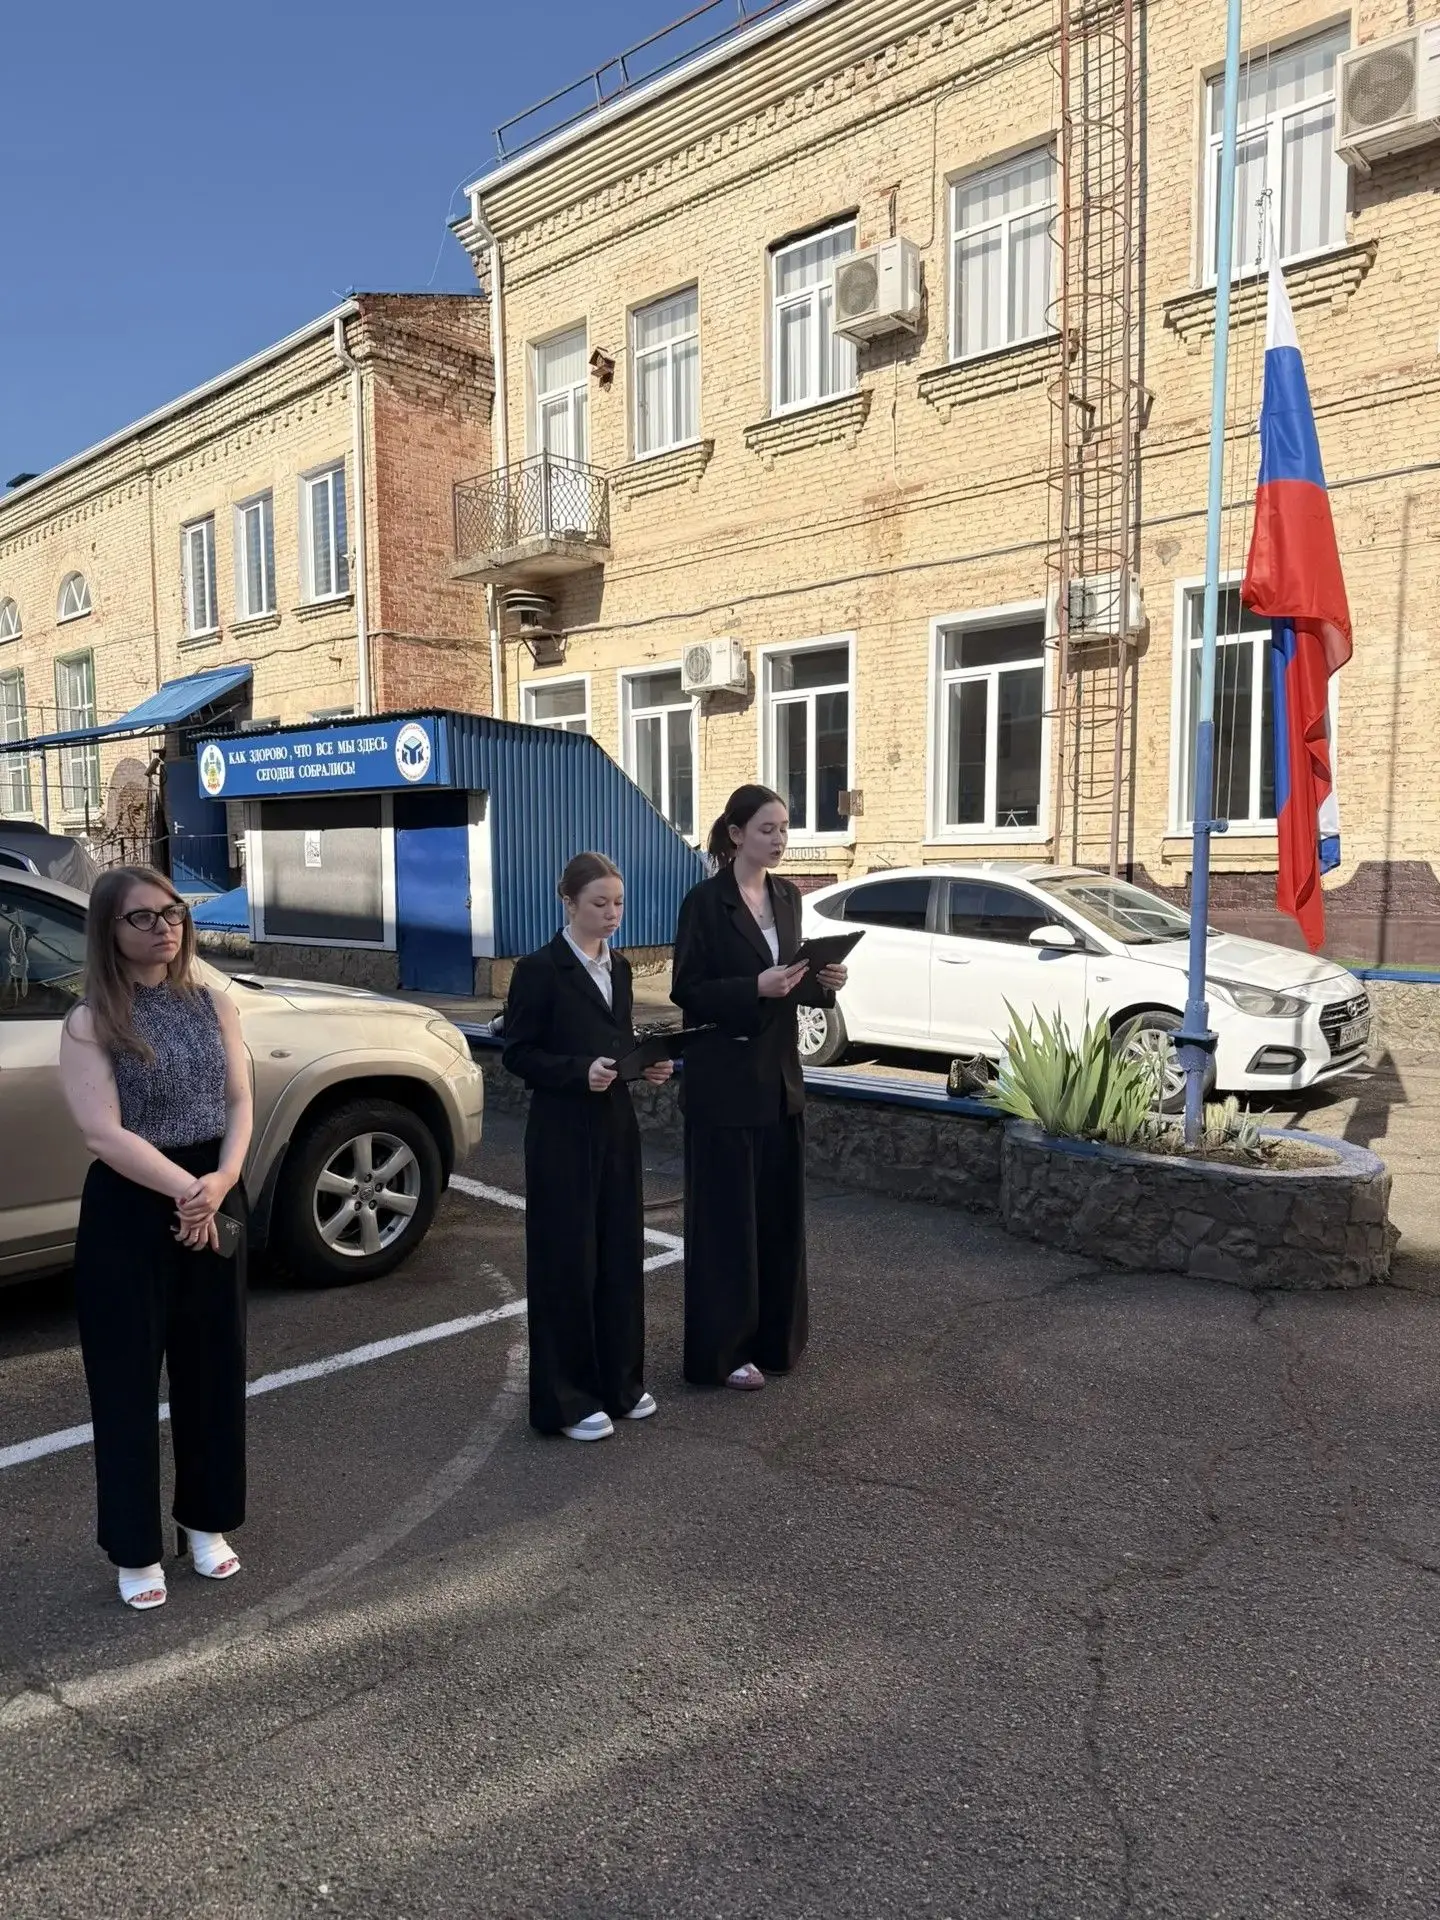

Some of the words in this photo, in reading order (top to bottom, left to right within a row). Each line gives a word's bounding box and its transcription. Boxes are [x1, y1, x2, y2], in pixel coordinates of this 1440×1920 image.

[229, 751, 247, 764] КАК
[294, 744, 312, 758] ЧТО
[316, 741, 334, 756] ВСЕ
[338, 739, 356, 754] МЫ
[357, 736, 388, 754] ЗДЕСЬ
[256, 766, 295, 782] СЕГОДНЯ
[298, 761, 356, 779] СОБРАЛИСЬ!
